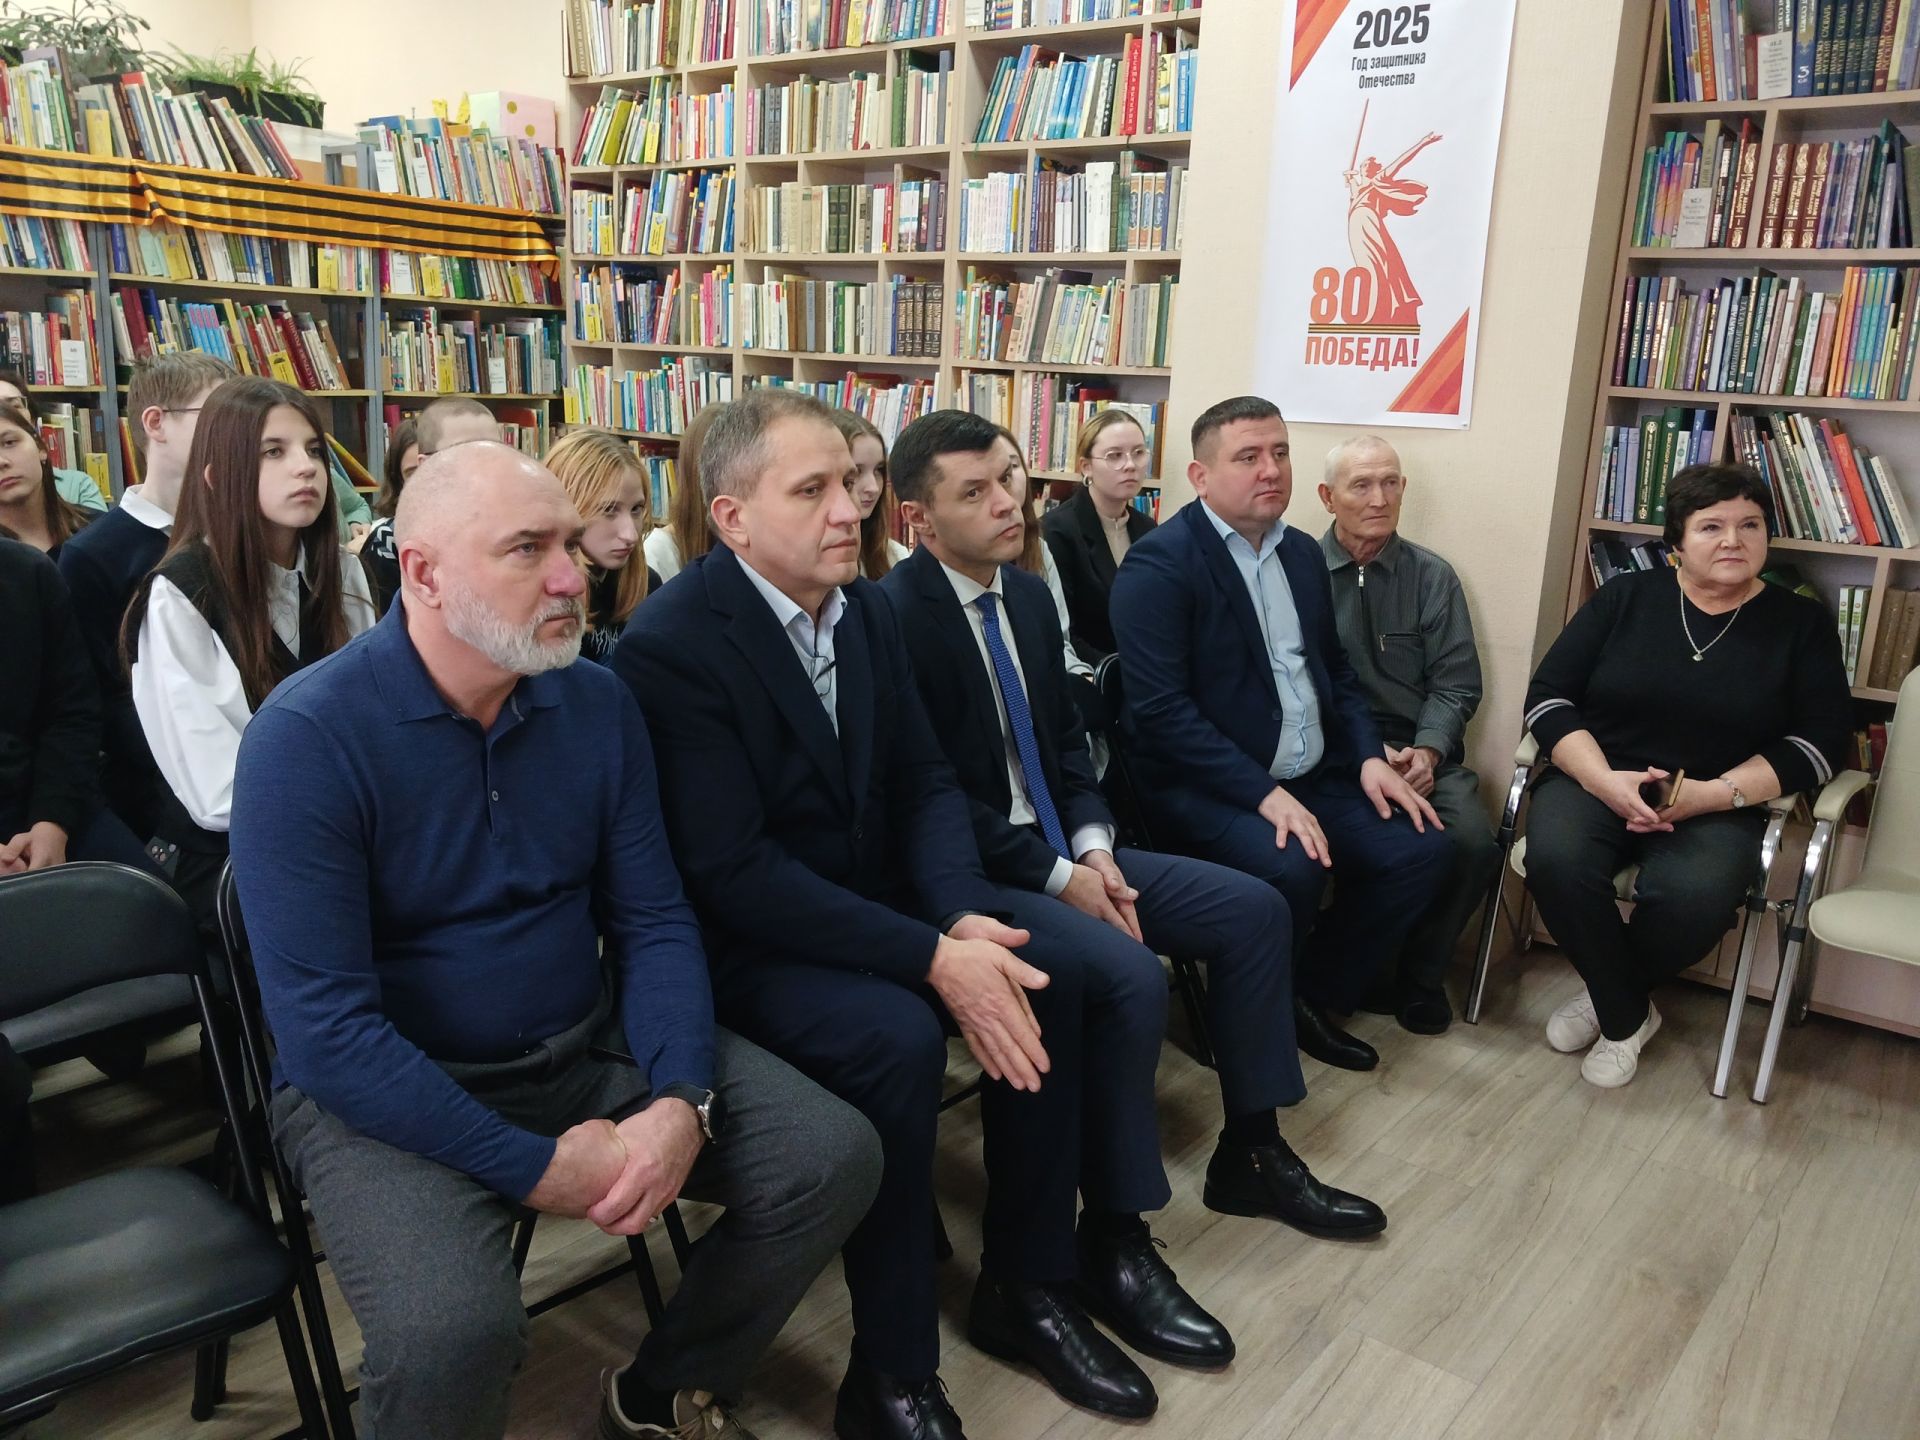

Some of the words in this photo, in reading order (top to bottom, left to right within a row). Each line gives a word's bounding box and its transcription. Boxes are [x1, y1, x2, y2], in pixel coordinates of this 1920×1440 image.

[1353, 4, 1431, 49] 2025
[1351, 56, 1368, 71] Год
[1370, 52, 1426, 69] защитника
[1358, 72, 1415, 89] Отечества
[1310, 266, 1372, 324] 80
[1305, 336, 1420, 371] ПОБЕДА!
